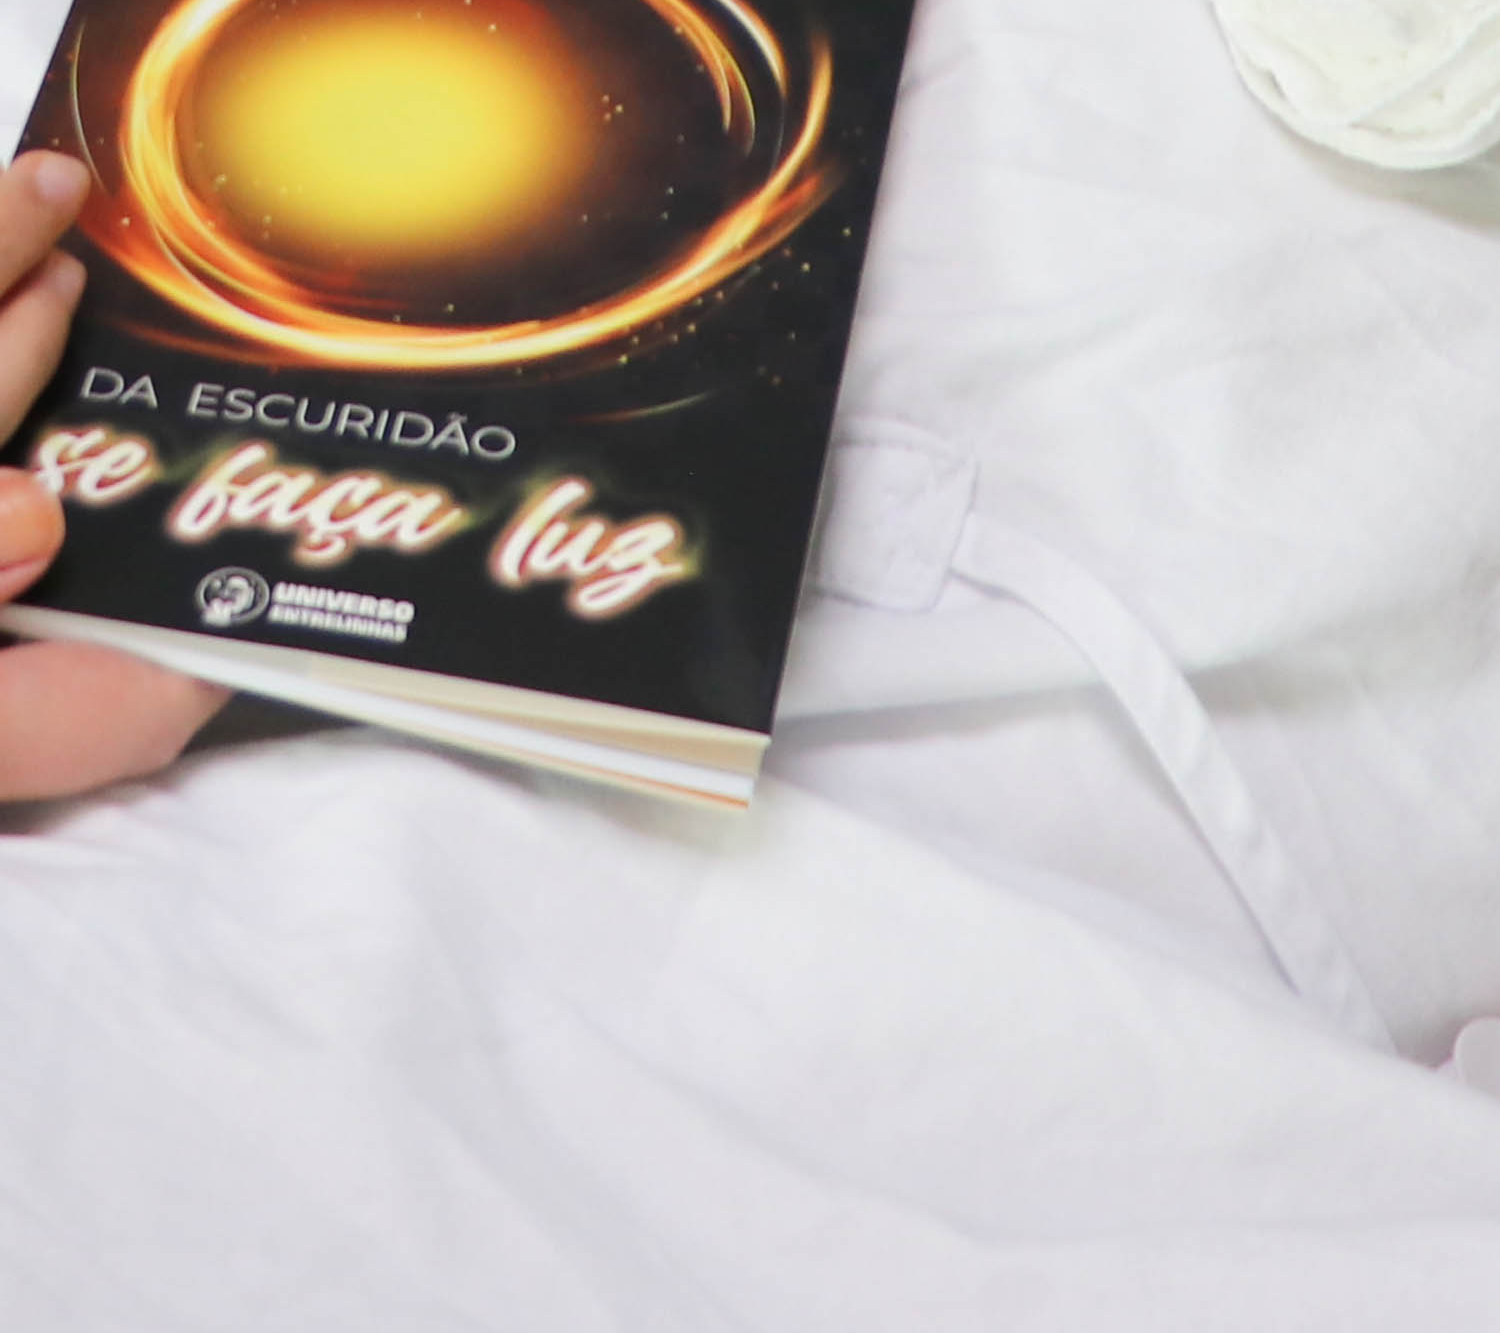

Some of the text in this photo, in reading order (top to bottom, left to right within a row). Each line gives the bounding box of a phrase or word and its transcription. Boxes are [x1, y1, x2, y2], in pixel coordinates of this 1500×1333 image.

[79, 367, 516, 460] DA ESCURIDÃO
[36, 426, 686, 613] se faça luz
[268, 604, 408, 643] ENTRELINHAS
[272, 581, 416, 624] UNIVERSO
